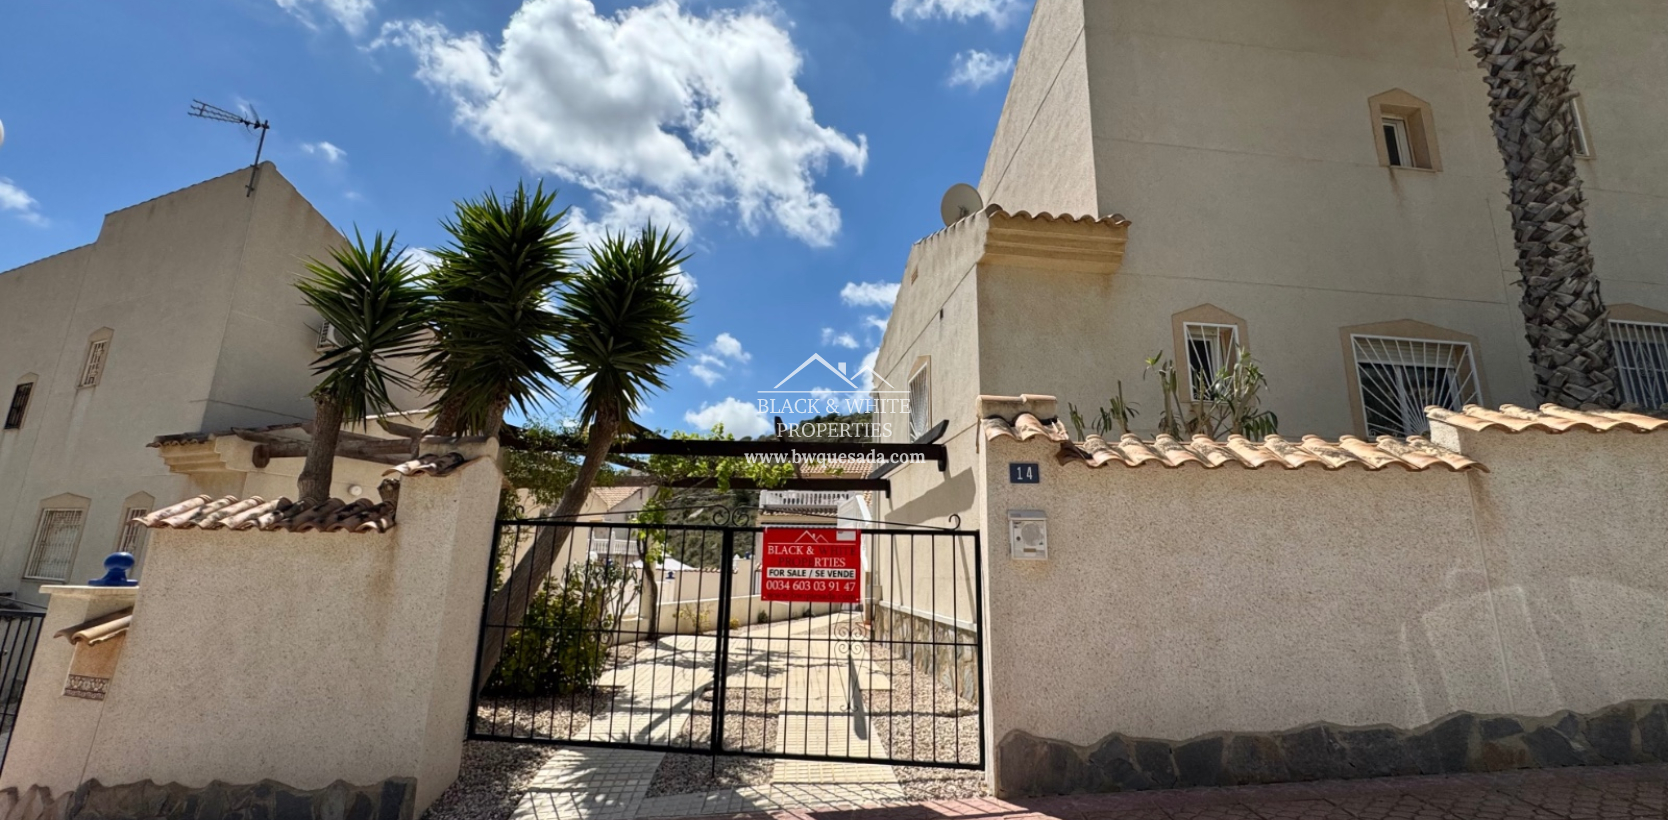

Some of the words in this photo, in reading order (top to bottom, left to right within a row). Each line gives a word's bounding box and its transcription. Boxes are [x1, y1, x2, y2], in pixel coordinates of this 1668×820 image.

[1016, 466, 1033, 480] 14
[768, 545, 804, 555] BLACK
[806, 545, 815, 555] &
[818, 546, 856, 556] WHITE
[778, 556, 846, 567] PROPERTIES
[768, 569, 785, 577] FOR
[787, 569, 807, 577] SALE
[815, 569, 825, 577] SE
[827, 570, 854, 578] VENDE
[766, 580, 790, 591] 0034
[792, 580, 811, 591] 603
[813, 580, 826, 591] 03
[828, 581, 840, 591] 91
[843, 582, 856, 592] 47
